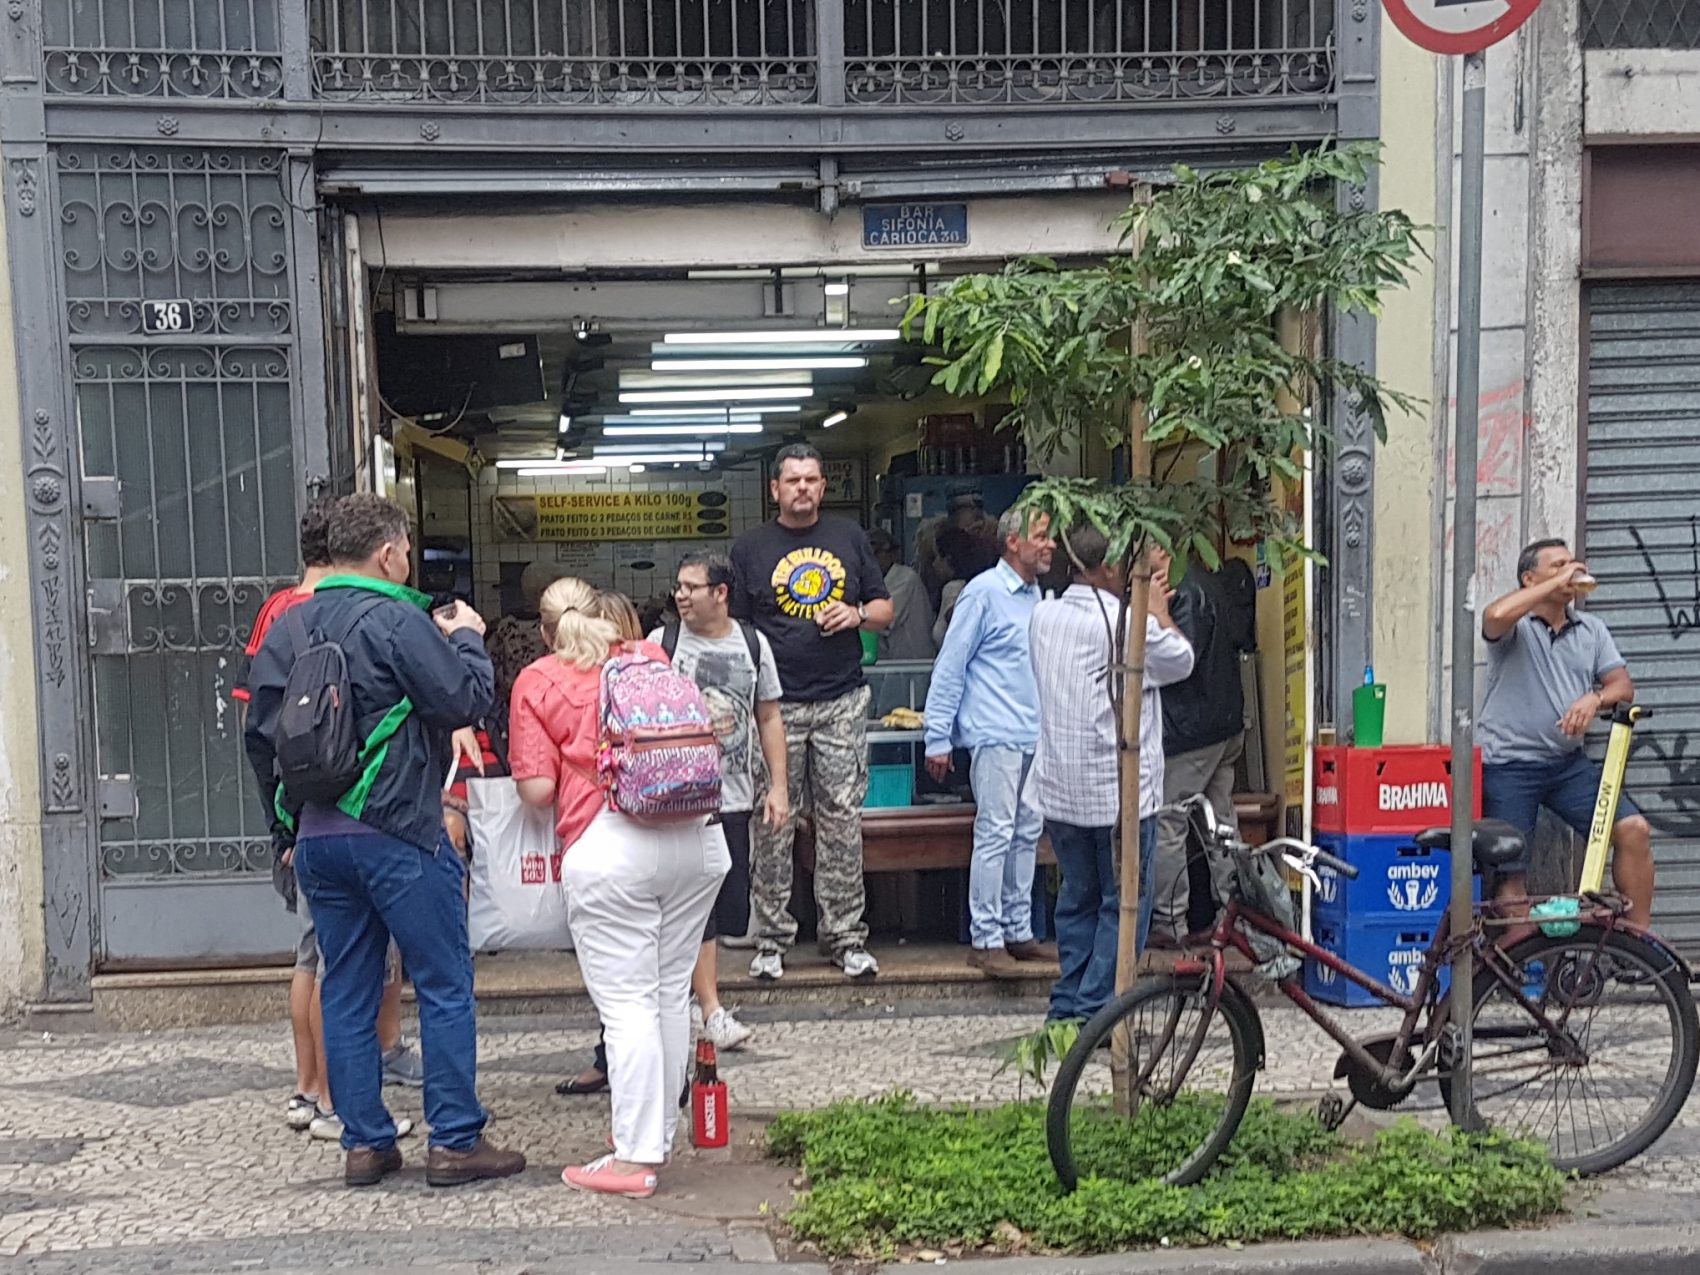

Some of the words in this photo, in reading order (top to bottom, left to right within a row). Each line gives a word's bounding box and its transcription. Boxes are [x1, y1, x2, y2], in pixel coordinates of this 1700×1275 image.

[900, 206, 934, 219] BAR
[881, 217, 945, 231] SIFONIA
[870, 230, 938, 245] CARIOCA
[154, 302, 182, 330] 36
[540, 495, 620, 509] SELF-SERVICE
[623, 494, 631, 507] A
[634, 494, 662, 507] KILO
[666, 493, 692, 508] 100g
[540, 513, 565, 524] PRATO
[567, 513, 589, 524] FEITO
[606, 511, 641, 525] PEDAÇOS
[643, 511, 653, 522] DE
[655, 511, 680, 521] CARNE
[540, 527, 566, 538] PRATO
[567, 527, 590, 537] FEITO
[606, 525, 642, 537] PEDAÇOS
[643, 525, 654, 535] DE
[655, 524, 680, 535] CARNE
[786, 546, 847, 581] BULLDOG
[1379, 782, 1448, 811] BRAHMA
[1590, 780, 1613, 845] YELLOW
[1387, 862, 1440, 879] ambev
[1388, 946, 1427, 966] amb
